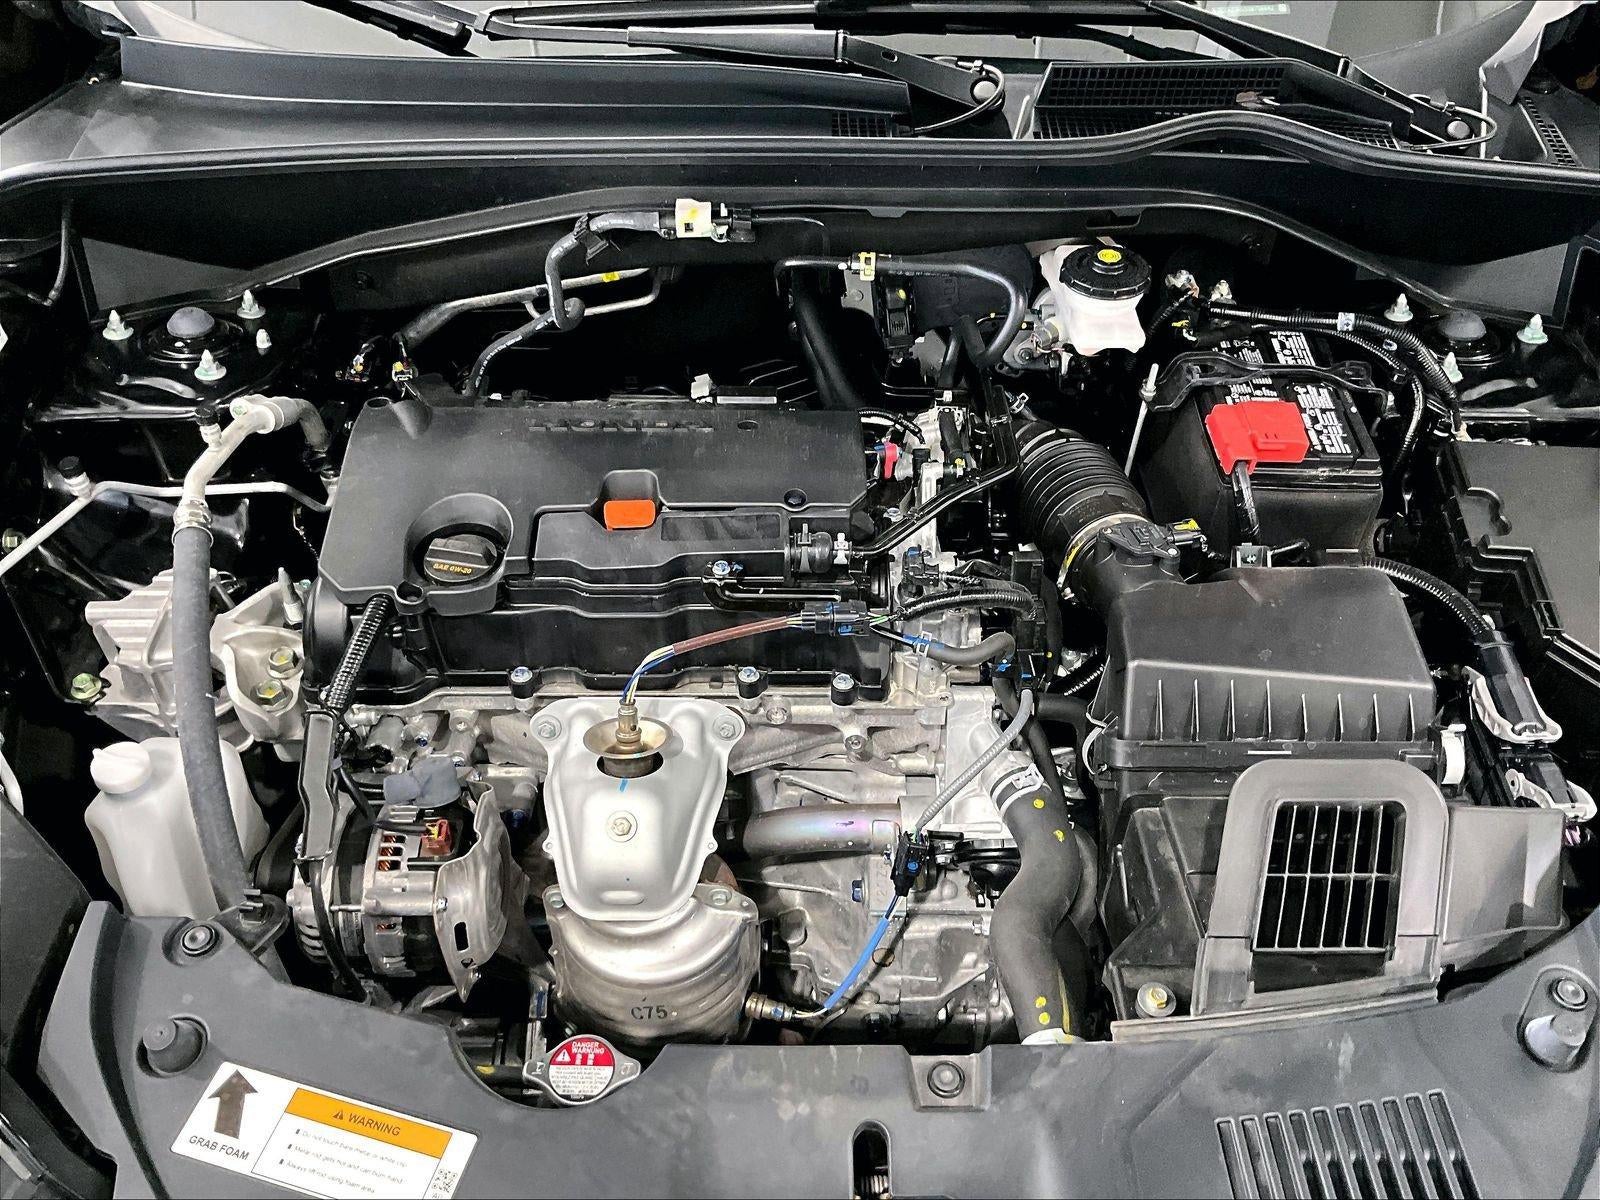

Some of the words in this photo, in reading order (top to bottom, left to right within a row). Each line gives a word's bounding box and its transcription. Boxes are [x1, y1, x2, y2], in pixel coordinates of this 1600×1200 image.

[631, 1004, 668, 1020] C75
[348, 1112, 401, 1136] WARNING
[189, 1135, 218, 1151] GRAB
[218, 1144, 250, 1160] FOAM
